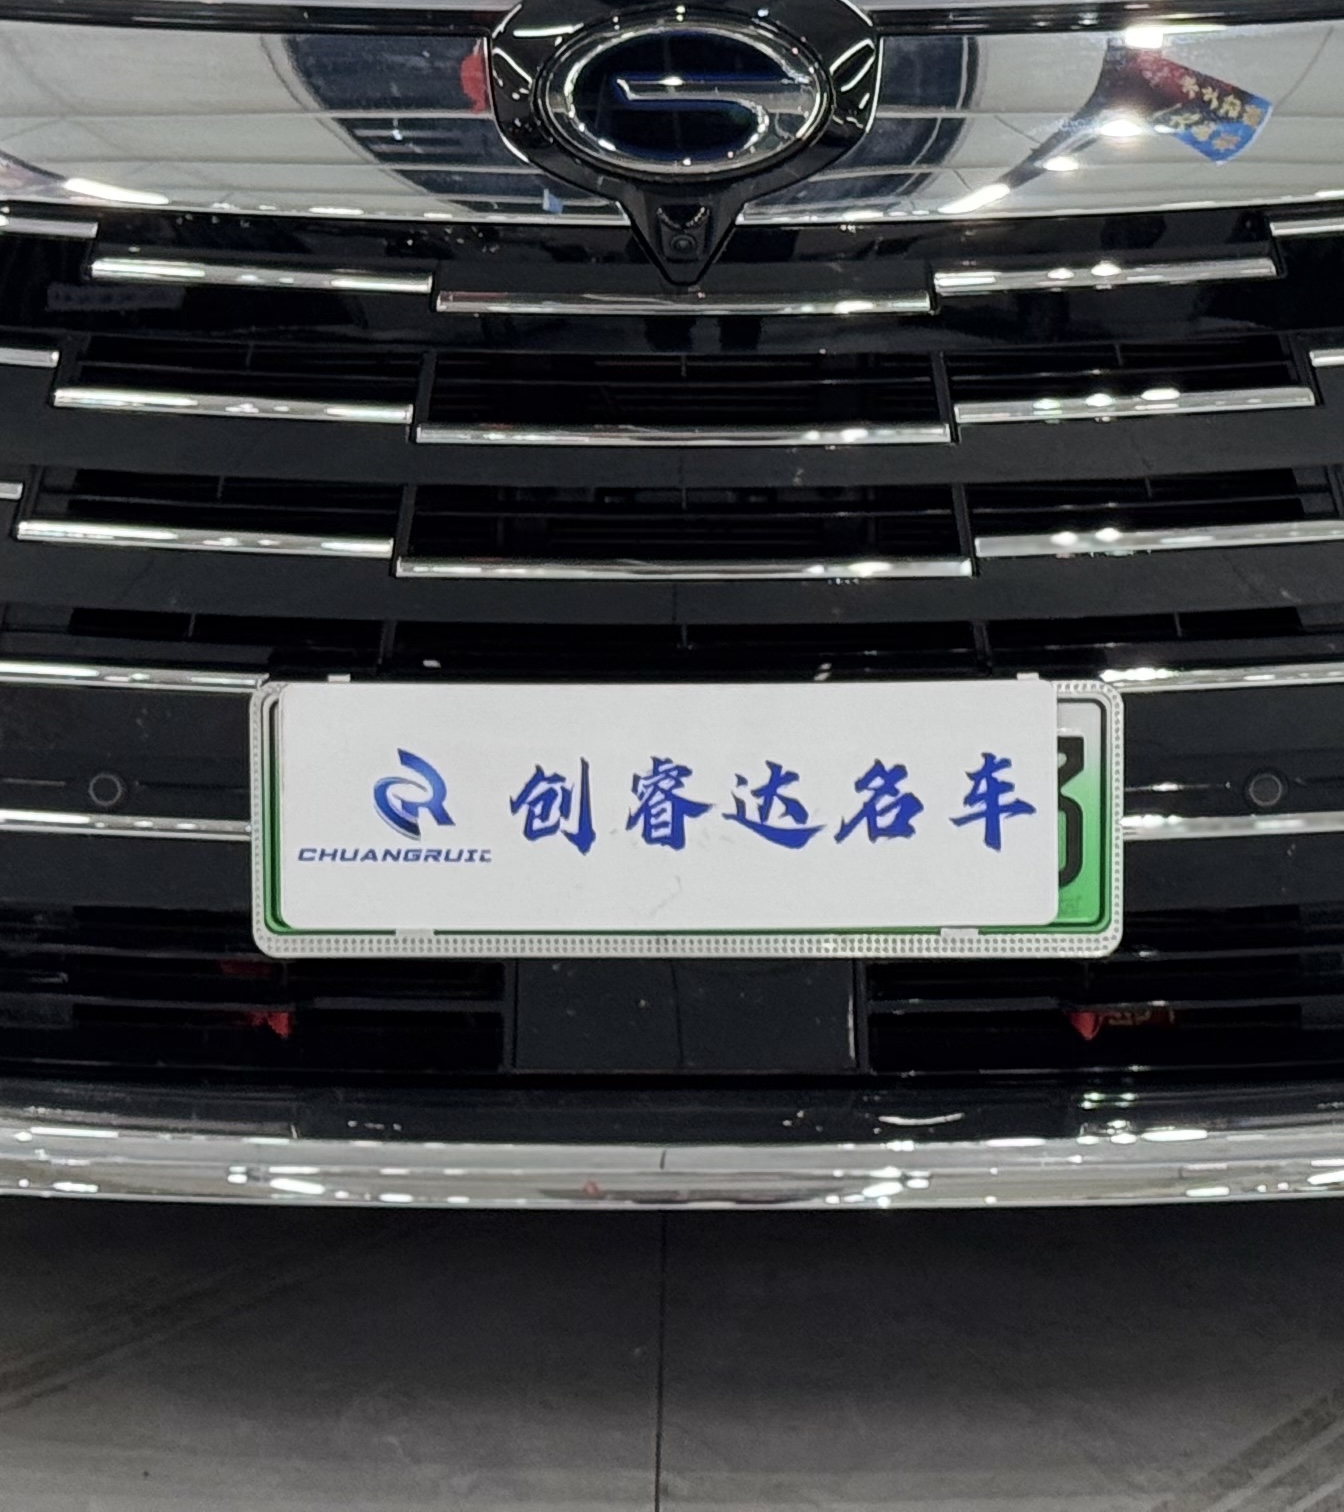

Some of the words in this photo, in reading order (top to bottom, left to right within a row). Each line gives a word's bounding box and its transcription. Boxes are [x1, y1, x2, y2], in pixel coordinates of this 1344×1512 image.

[510, 752, 1037, 854] 创睿达名车
